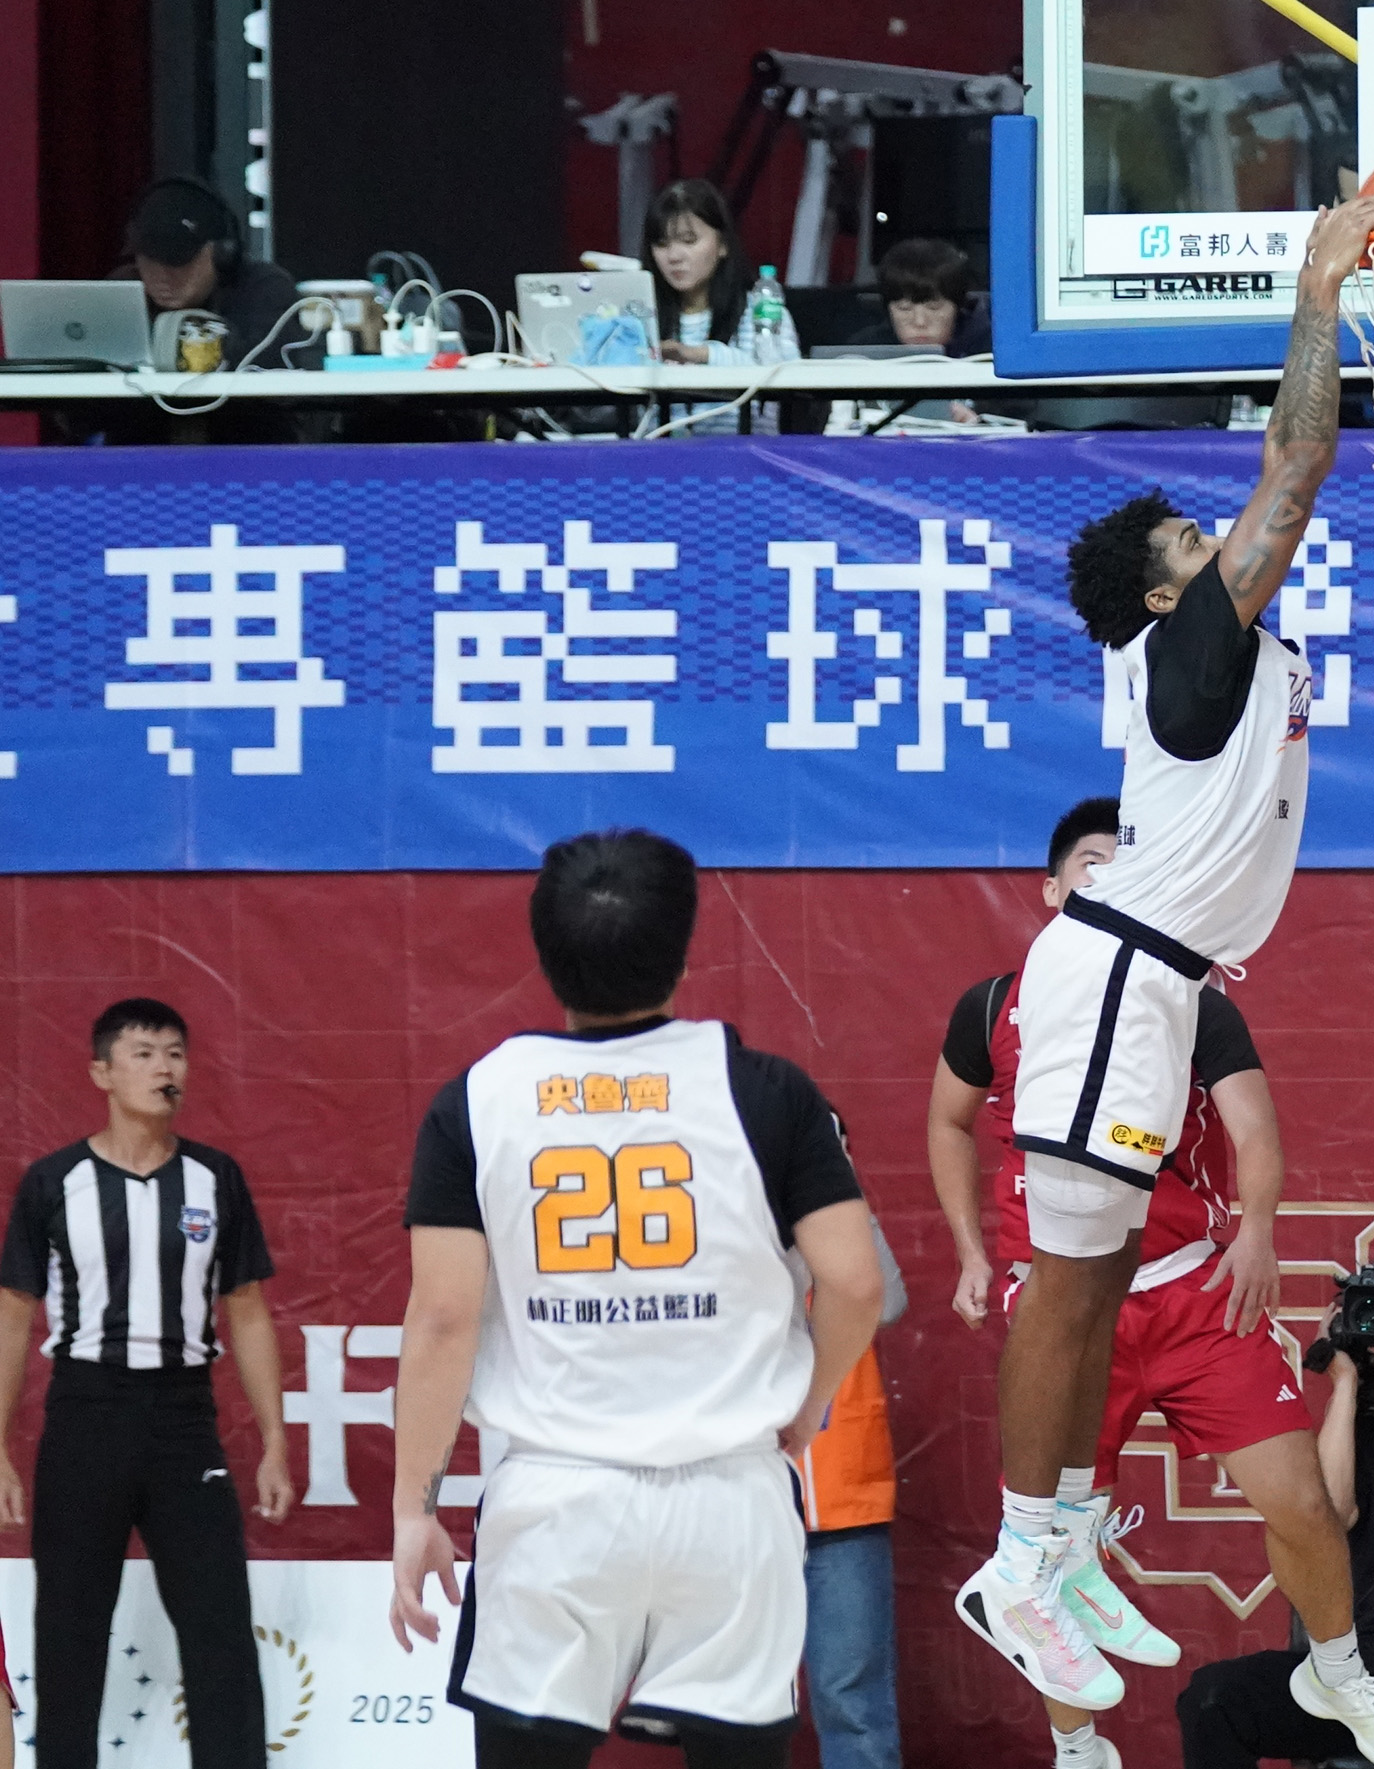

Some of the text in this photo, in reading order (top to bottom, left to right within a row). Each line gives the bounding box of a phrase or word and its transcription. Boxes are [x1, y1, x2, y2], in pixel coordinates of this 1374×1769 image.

[1179, 232, 1288, 257] 富邦人壽
[1154, 274, 1274, 293] GARED
[530, 1141, 698, 1274] 26
[527, 1292, 718, 1325] 林正明公益籃球
[349, 1695, 435, 1725] 2025
